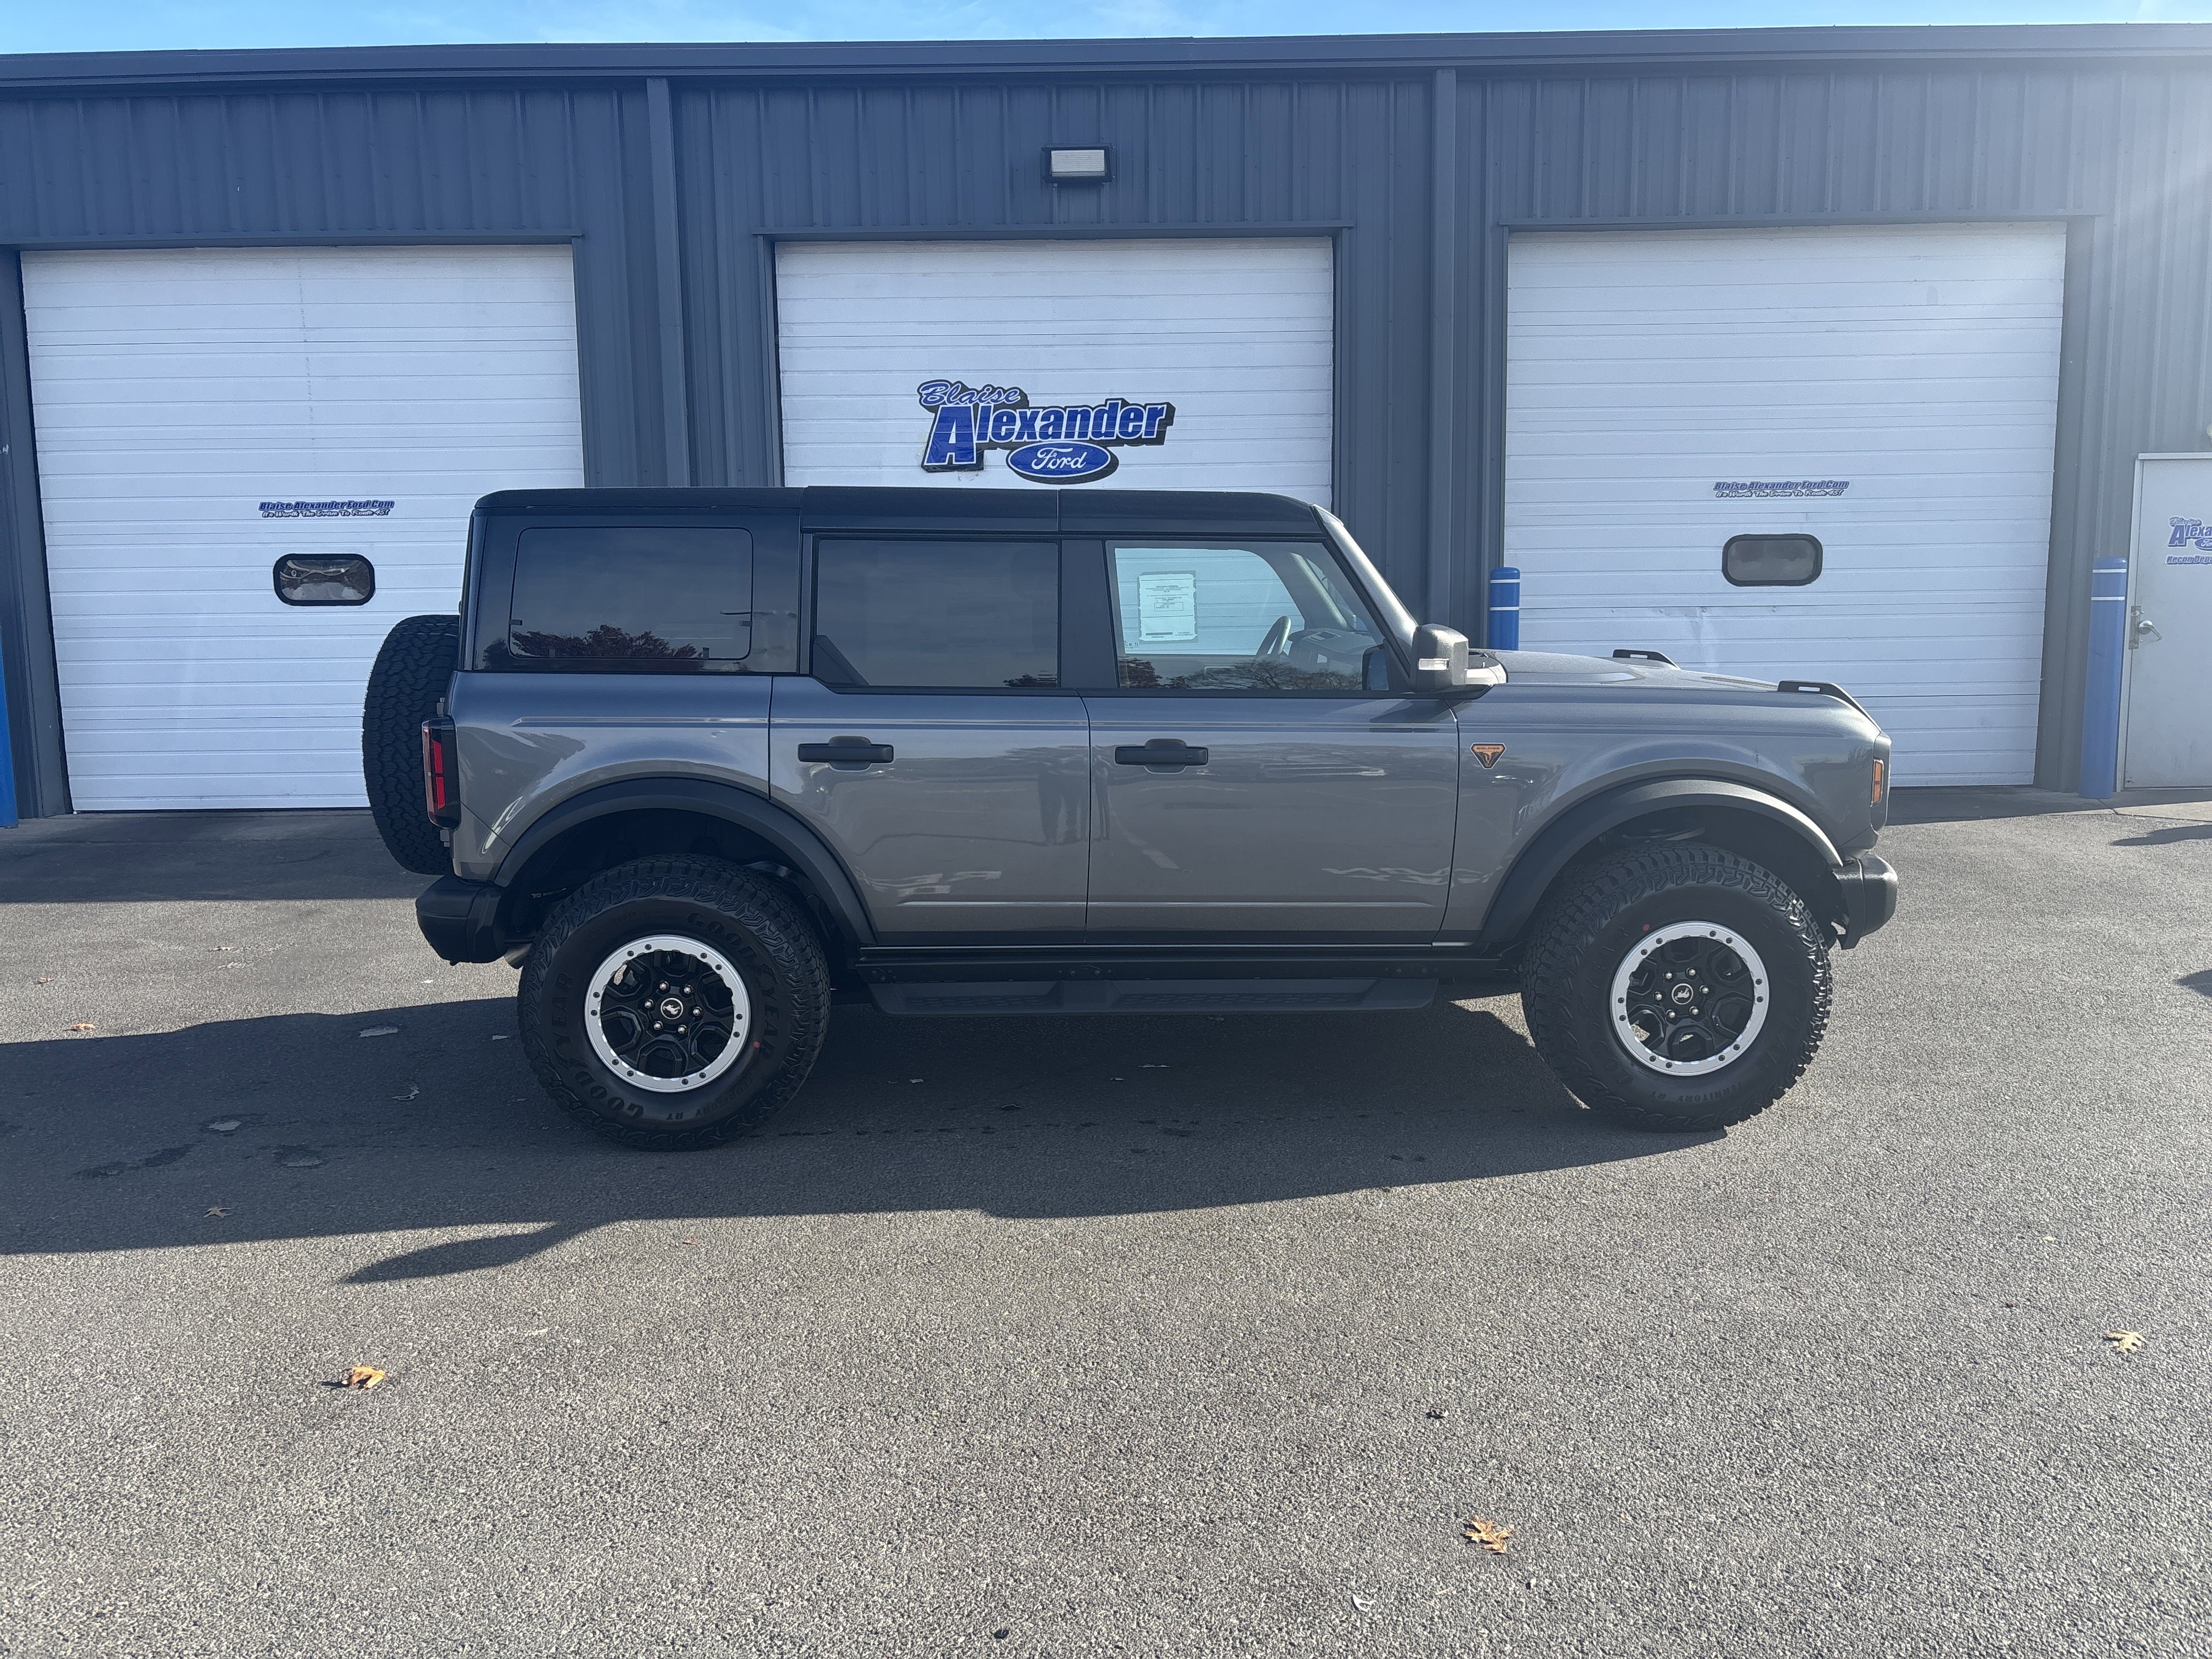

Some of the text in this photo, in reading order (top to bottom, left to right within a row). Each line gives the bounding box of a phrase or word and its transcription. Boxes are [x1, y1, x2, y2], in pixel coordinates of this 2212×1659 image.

[920, 381, 1020, 406] Blaise
[924, 400, 1167, 465] Alexander
[1031, 447, 1087, 470] Ford
